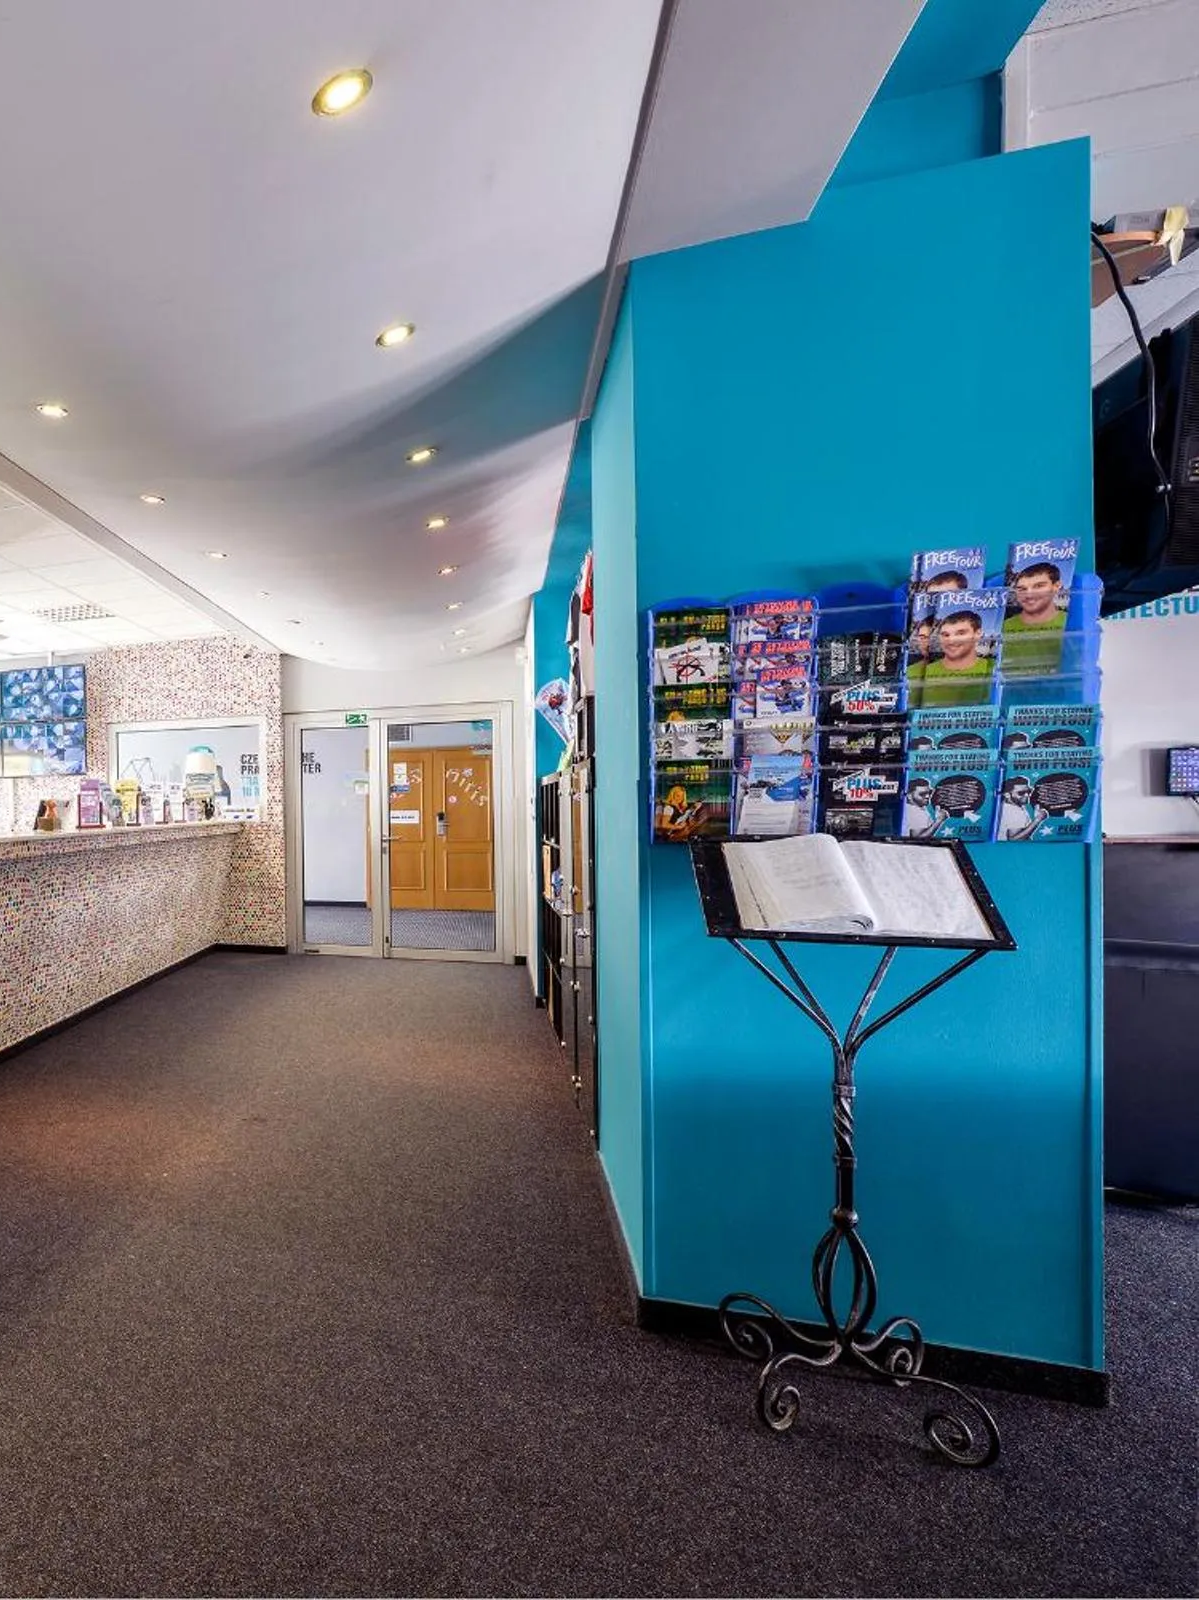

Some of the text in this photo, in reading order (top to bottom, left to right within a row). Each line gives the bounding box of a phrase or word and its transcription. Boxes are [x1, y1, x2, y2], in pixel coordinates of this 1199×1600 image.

[924, 551, 956, 569] FREE
[955, 555, 983, 568] TOUR
[1015, 541, 1078, 562] FREE TOUR
[940, 592, 973, 610] FREE
[846, 689, 882, 700] PLUS
[846, 776, 882, 790] PLUS
